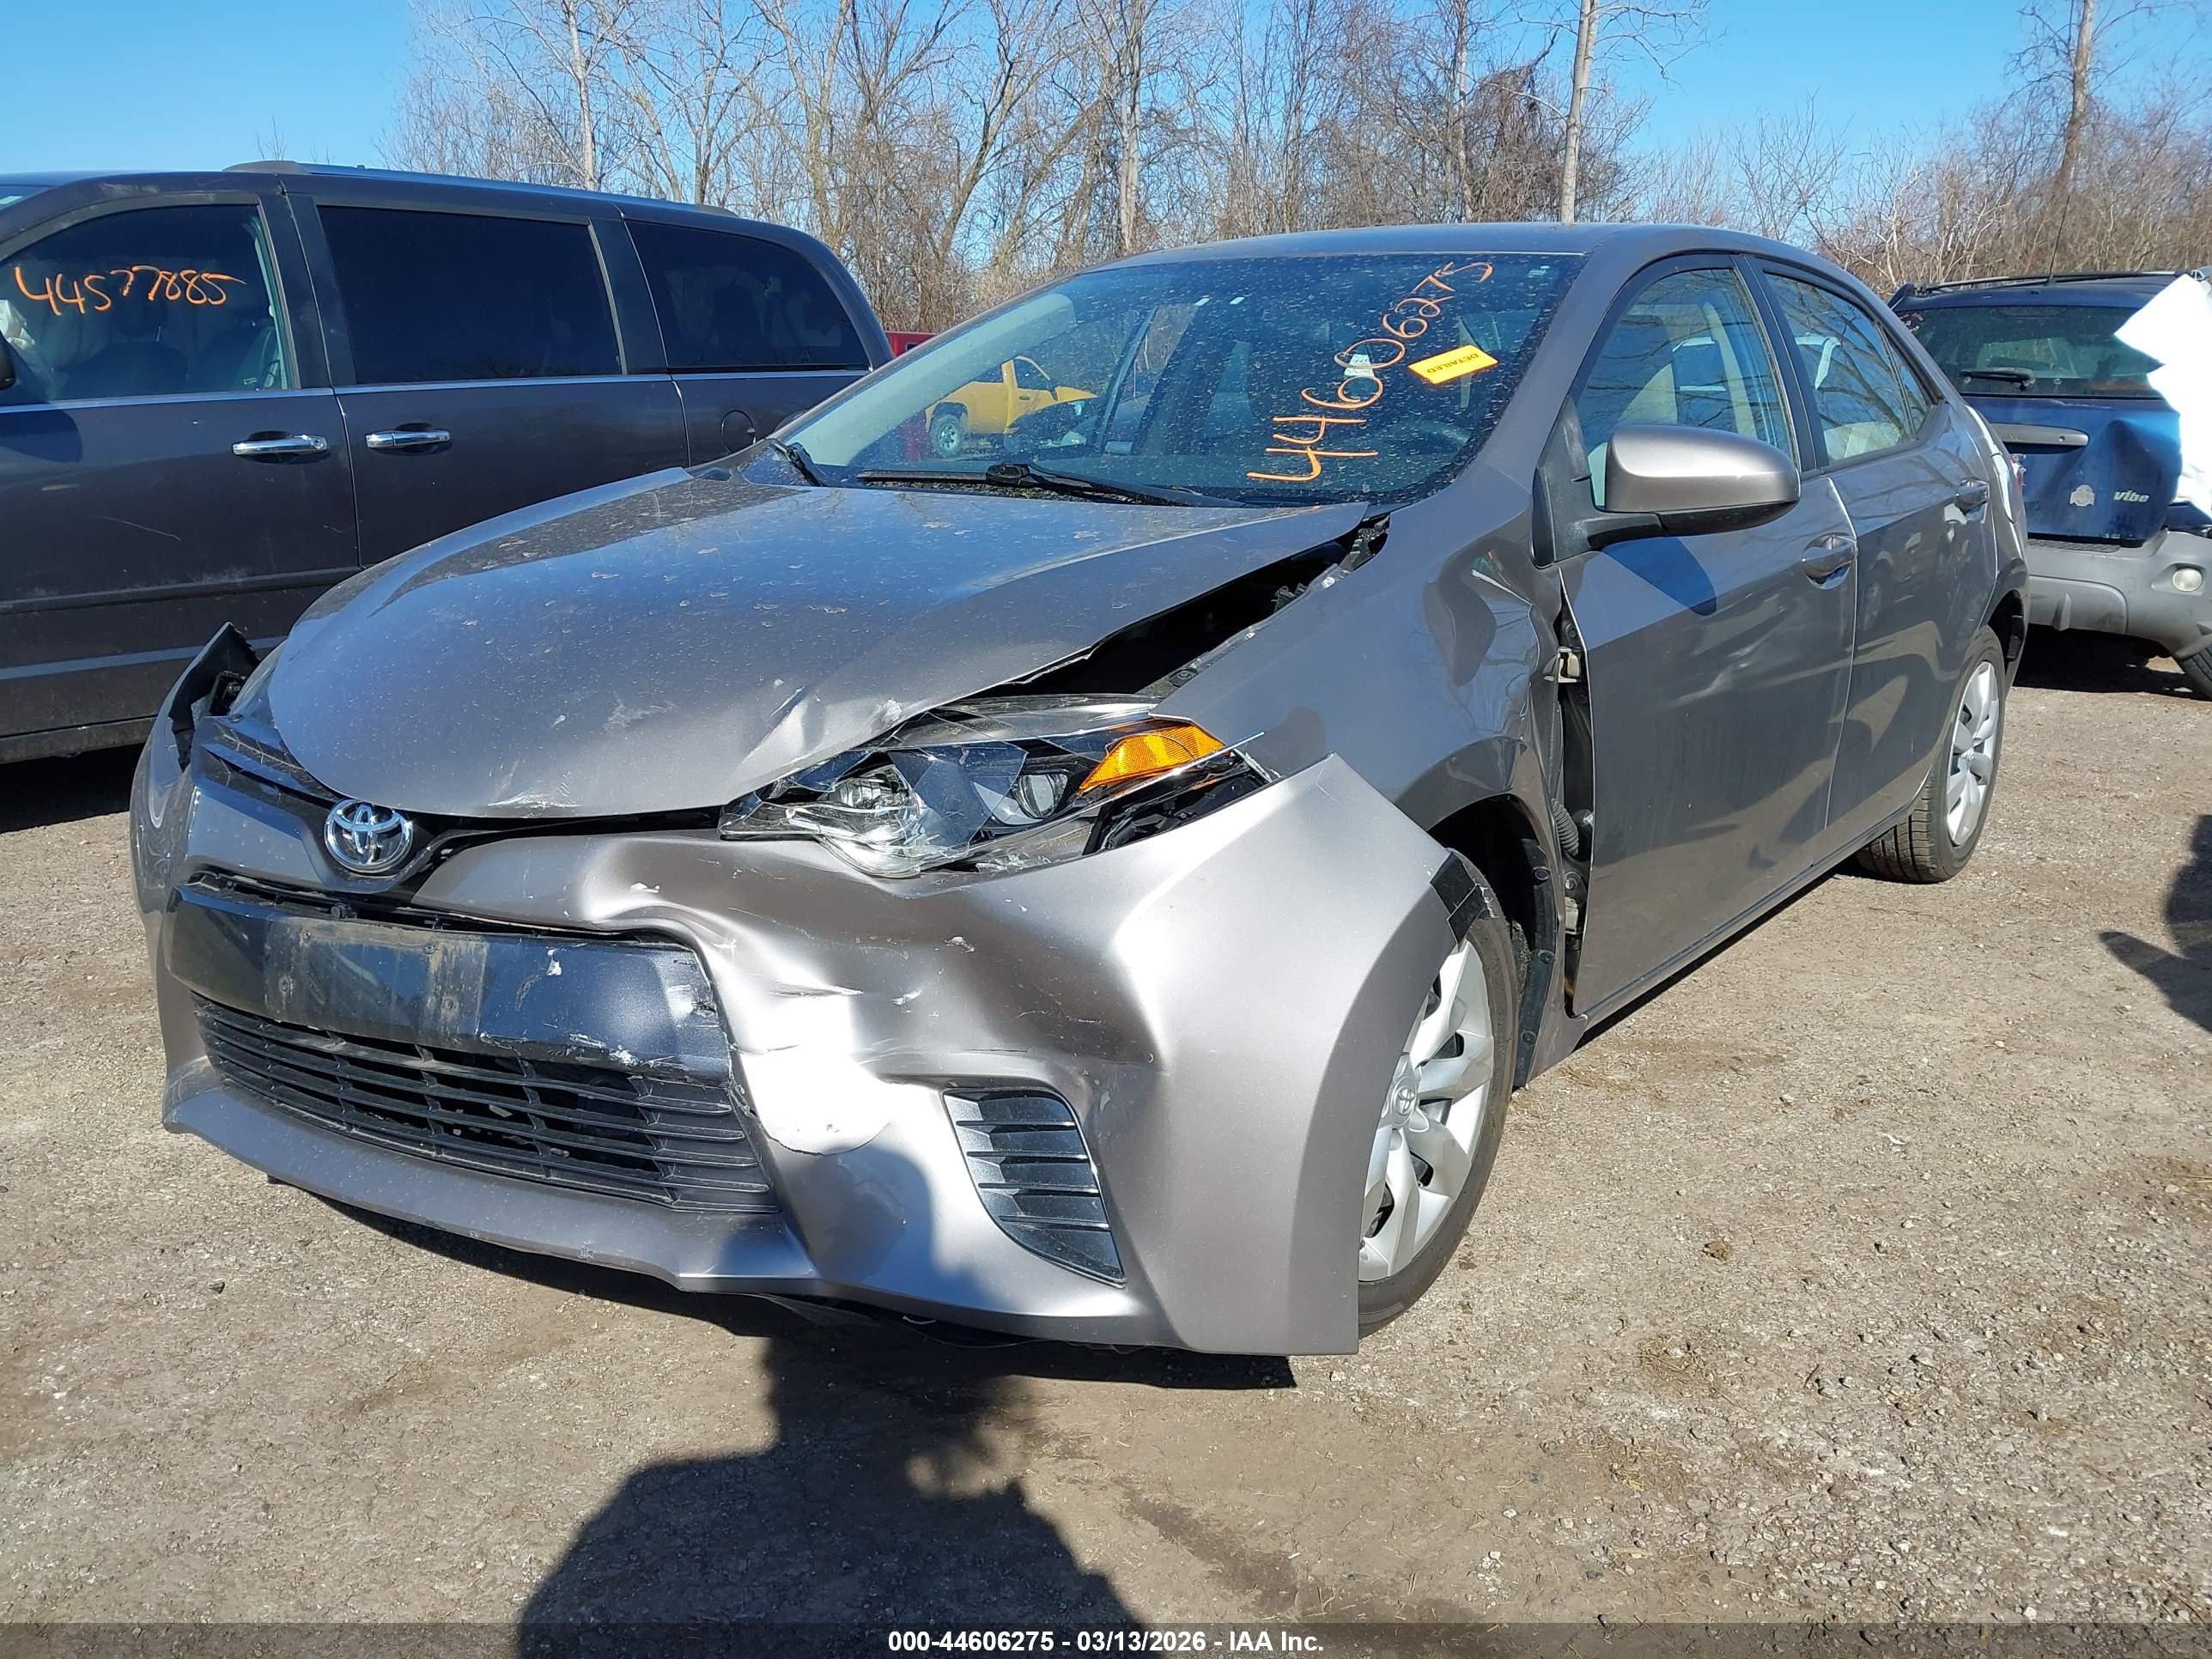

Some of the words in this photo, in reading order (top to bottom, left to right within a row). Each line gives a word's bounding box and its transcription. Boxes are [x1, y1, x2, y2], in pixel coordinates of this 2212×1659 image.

[14, 265, 246, 316] 44577885
[1246, 261, 1493, 482] 44606275
[1426, 353, 1480, 374] DETAILED
